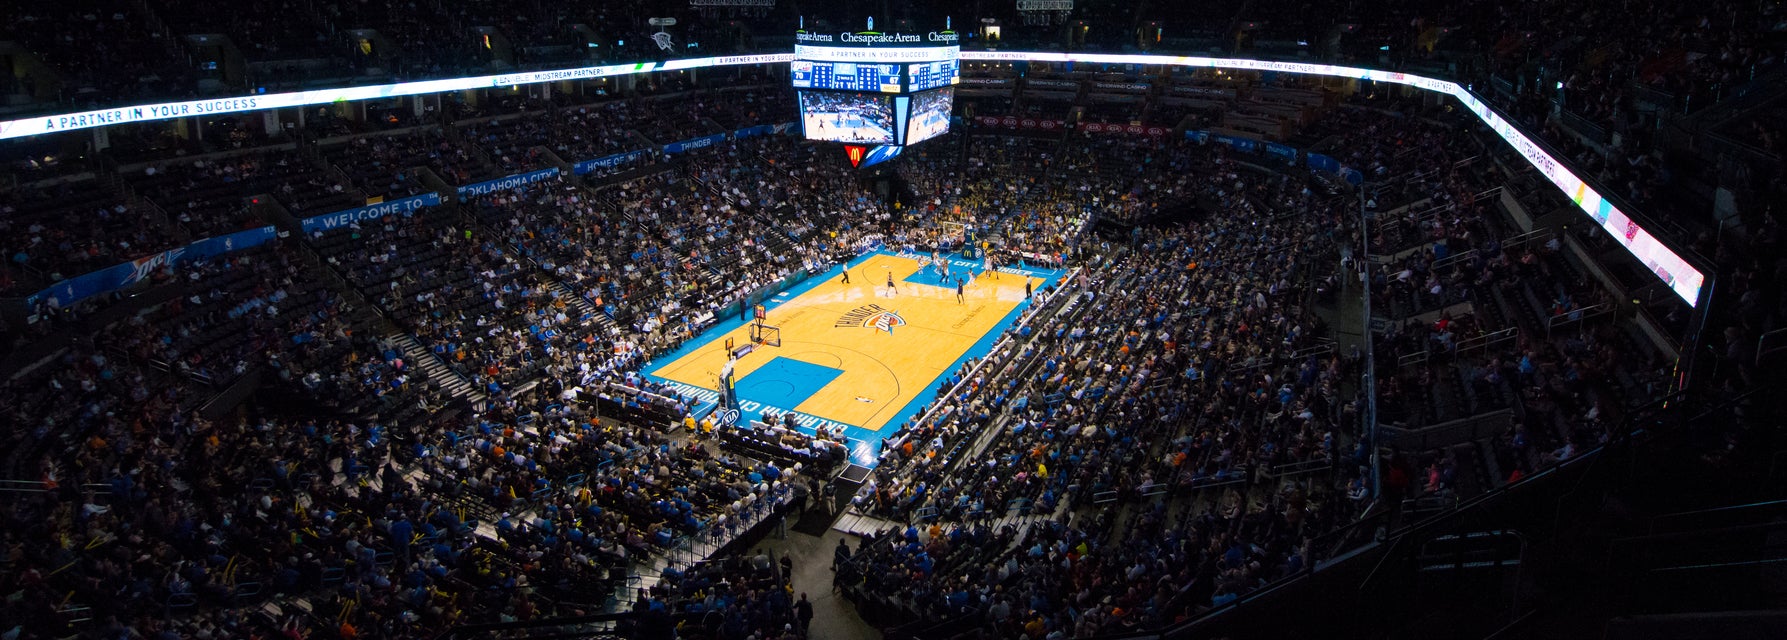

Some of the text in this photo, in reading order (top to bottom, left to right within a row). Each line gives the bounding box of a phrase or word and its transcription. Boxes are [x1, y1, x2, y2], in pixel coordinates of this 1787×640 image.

[813, 32, 833, 41] Arena
[841, 32, 921, 46] Chesapeake Arena
[534, 70, 572, 81] MIDSTREAM
[574, 68, 604, 78] PARTNERS
[890, 76, 899, 84] 67
[46, 98, 257, 131] A PARTNER IN YOUR SUCCESS
[681, 138, 711, 151] THUNDER
[587, 159, 612, 172] HOME
[468, 170, 552, 196] OKLAHOMA CITY
[322, 198, 423, 229] WELCOME TO
[302, 218, 315, 226] 114
[953, 260, 979, 268] CITY
[835, 303, 887, 328] THUNDER
[758, 404, 849, 433] OKLAHMA
